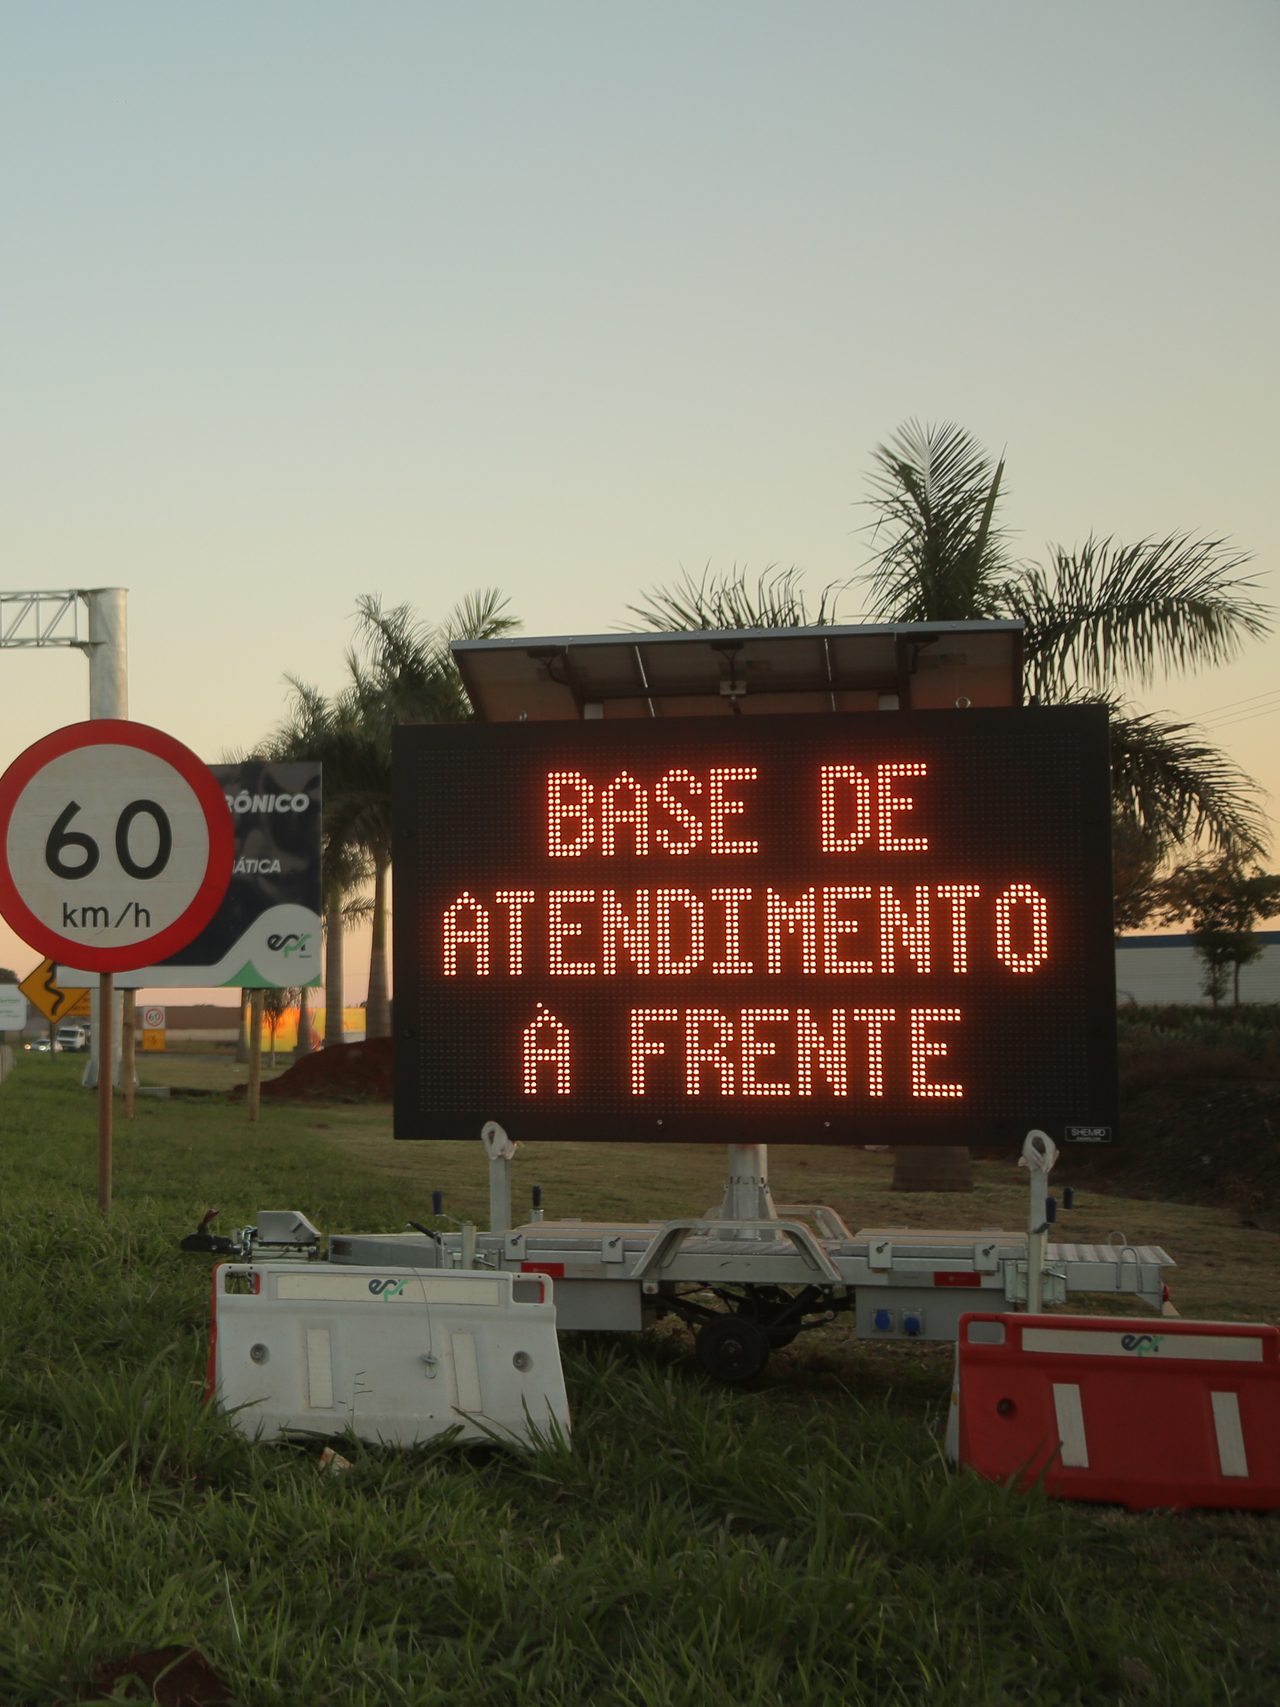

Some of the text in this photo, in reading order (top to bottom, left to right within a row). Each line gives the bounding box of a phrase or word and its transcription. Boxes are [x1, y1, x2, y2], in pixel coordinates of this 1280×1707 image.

[45, 799, 172, 880] 60
[547, 763, 928, 857] BASE DE
[232, 857, 281, 873] ÁTICA
[63, 902, 151, 928] km/h
[443, 884, 1048, 976] ATENDIMENTO
[523, 1002, 963, 1097] À FRENTE
